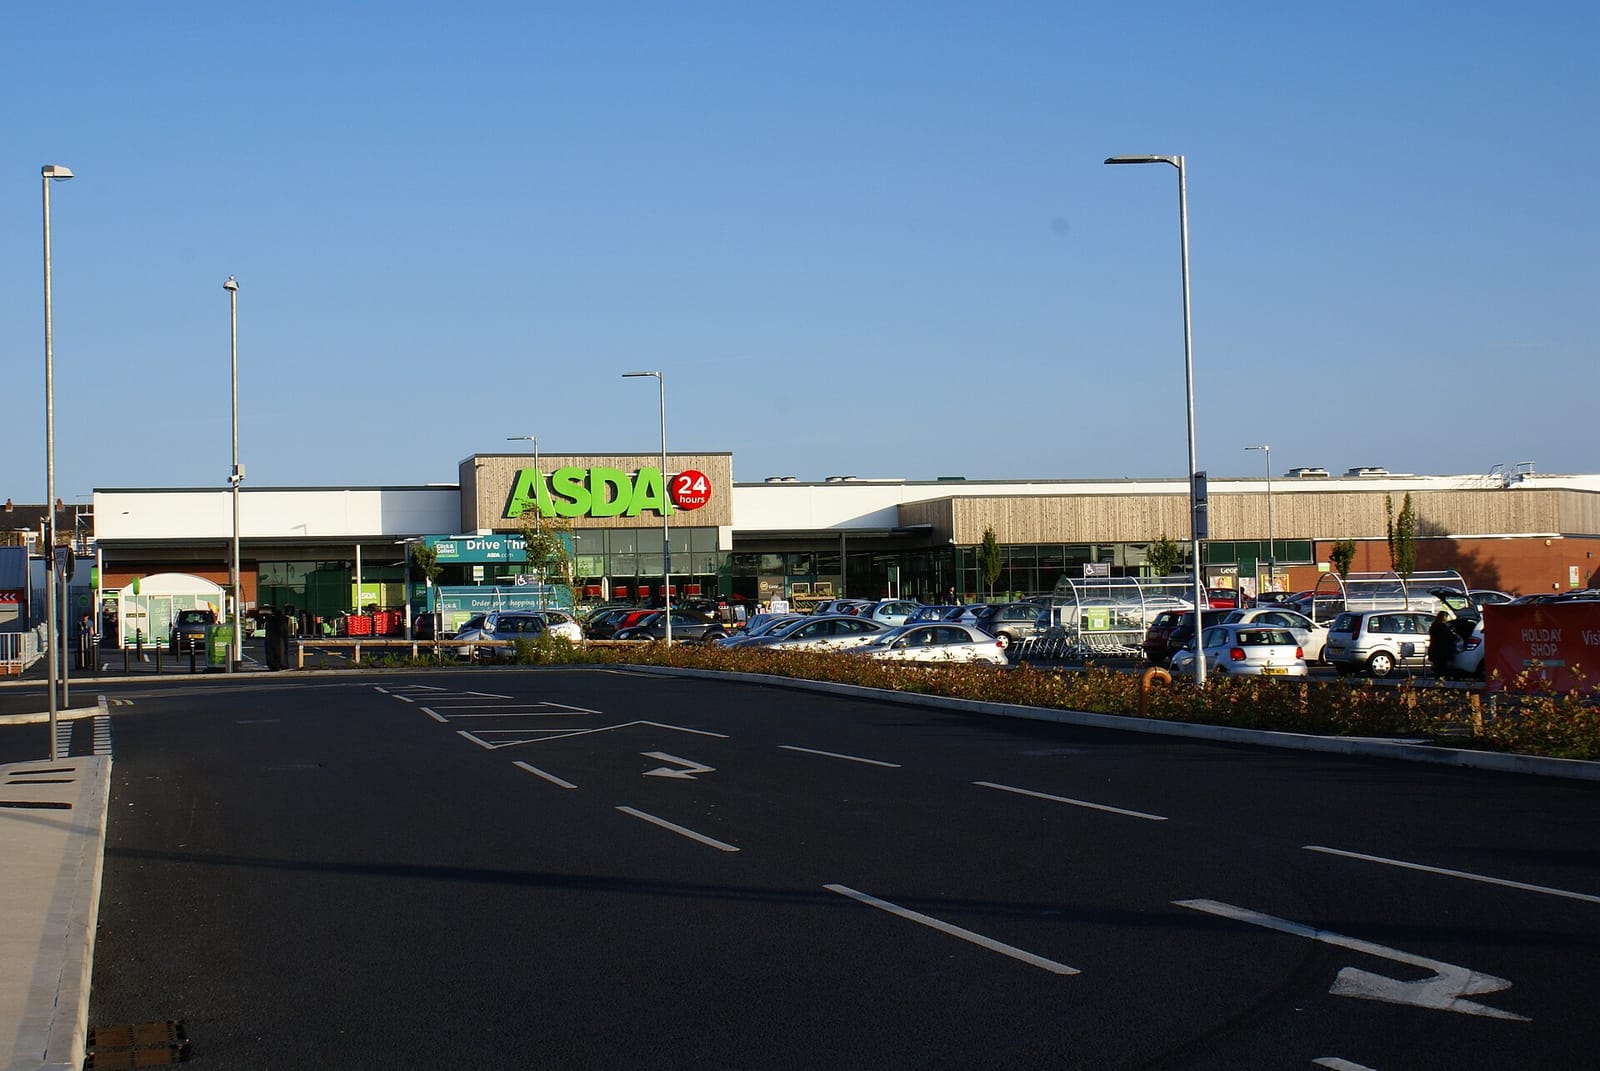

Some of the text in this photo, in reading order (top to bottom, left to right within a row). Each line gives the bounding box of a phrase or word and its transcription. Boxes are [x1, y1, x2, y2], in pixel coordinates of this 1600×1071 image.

[678, 476, 707, 494] 24
[507, 467, 674, 517] ASDA
[680, 495, 705, 503] hours
[466, 540, 499, 550] Drive
[508, 600, 535, 608] hopping
[1521, 628, 1561, 641] HOLIDAY
[1530, 643, 1557, 656] SHOP
